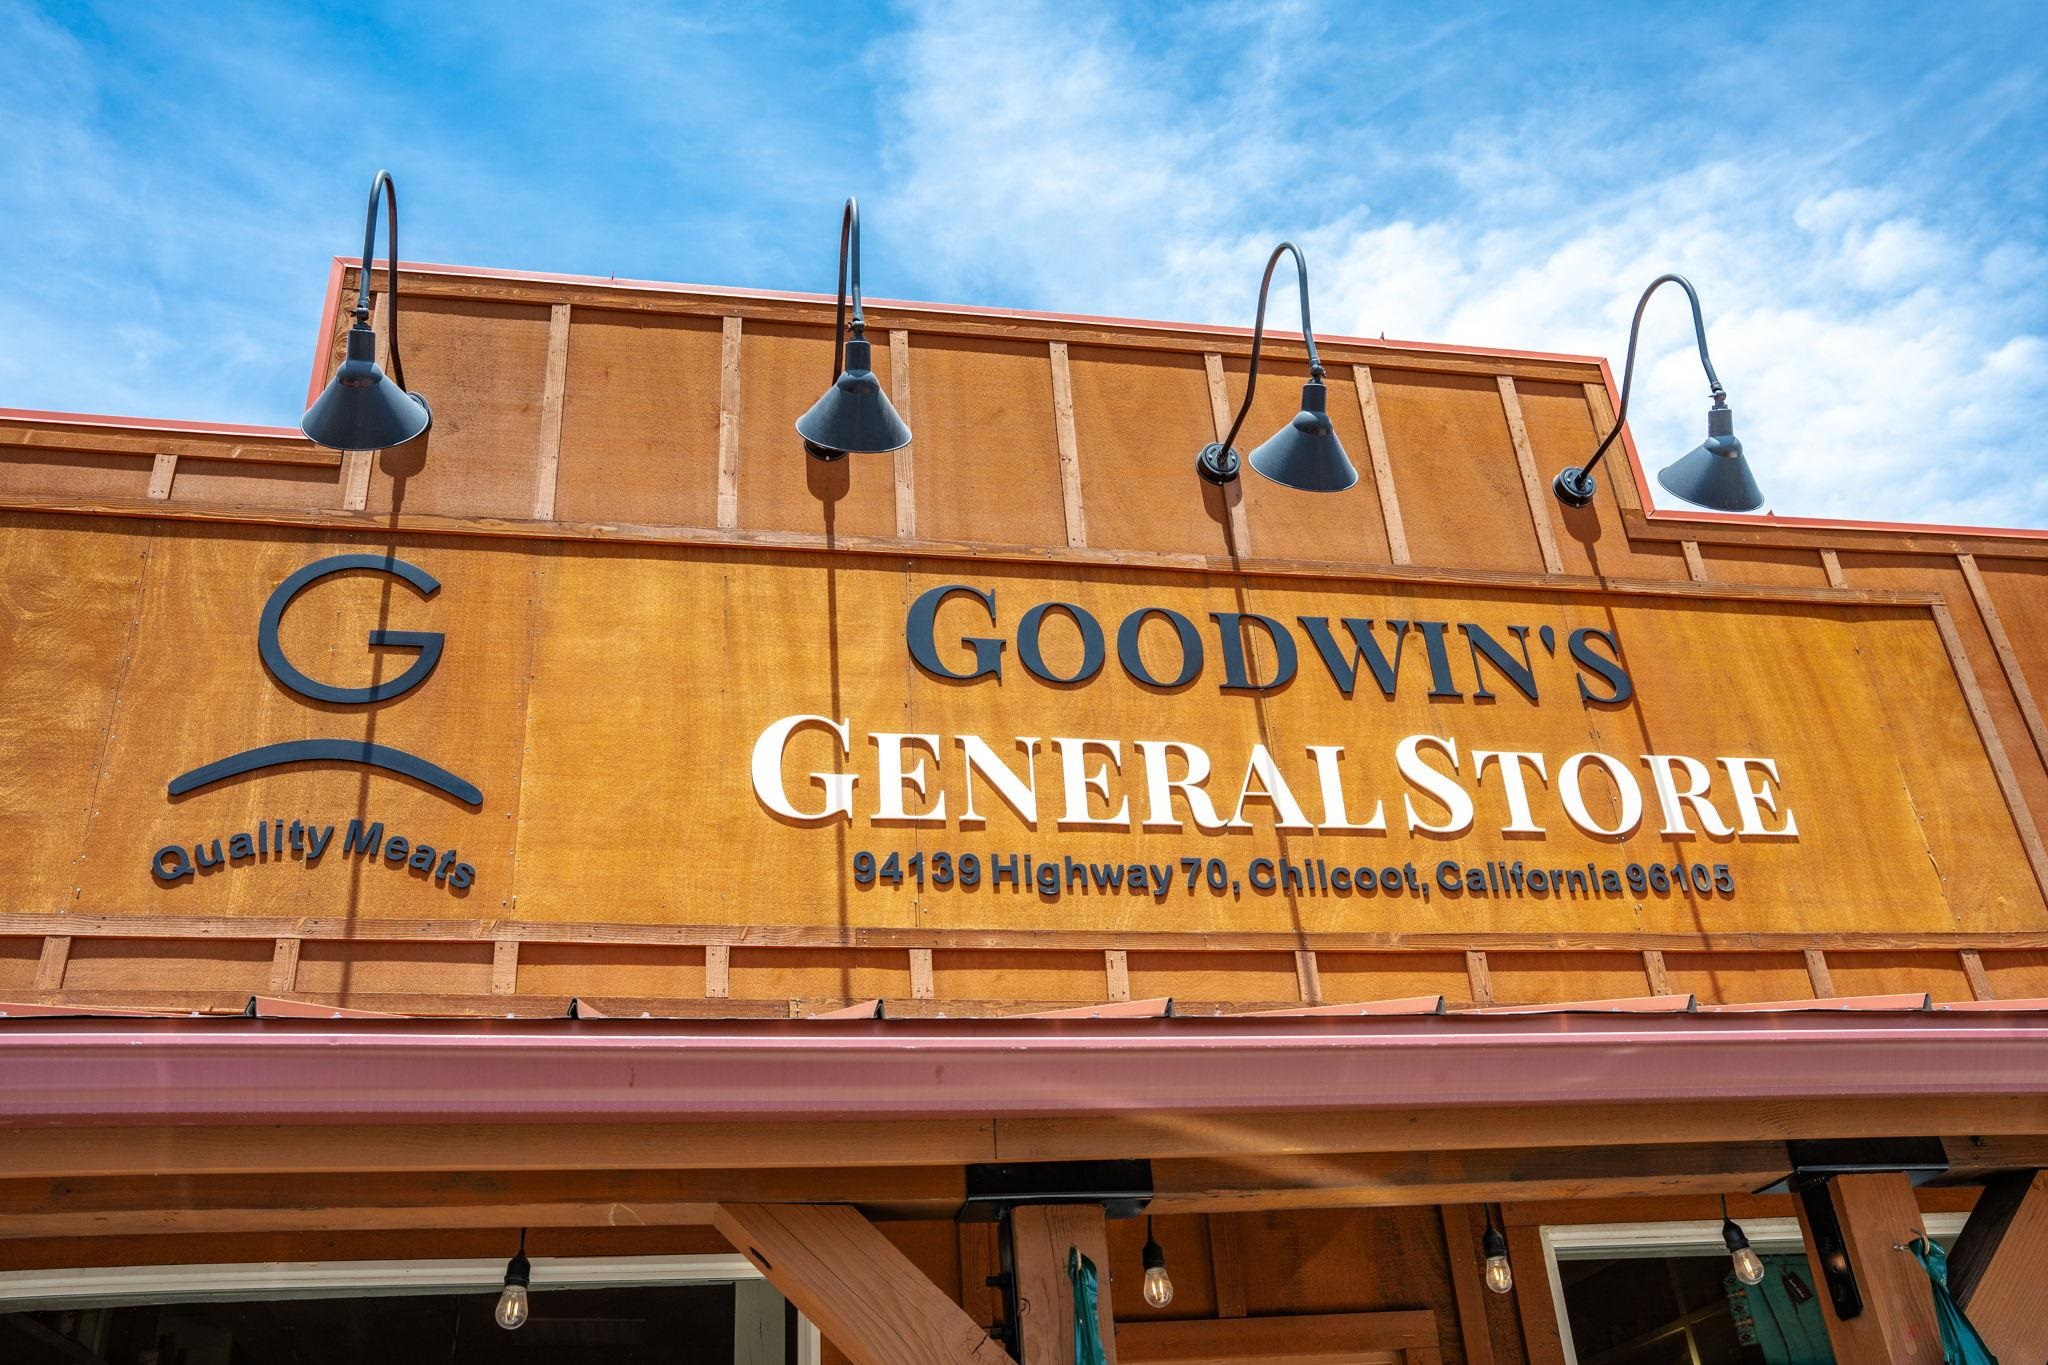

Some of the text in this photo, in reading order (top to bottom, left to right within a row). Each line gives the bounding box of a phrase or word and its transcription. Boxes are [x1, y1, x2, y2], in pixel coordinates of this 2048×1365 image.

[258, 554, 445, 704] G
[907, 585, 1632, 704] GOODWIN'S
[751, 714, 1800, 837] GENERAL STORE
[151, 819, 476, 889] Quality Meats
[853, 851, 1735, 896] 94139 Highway 70, Chilcoot, California 96105
